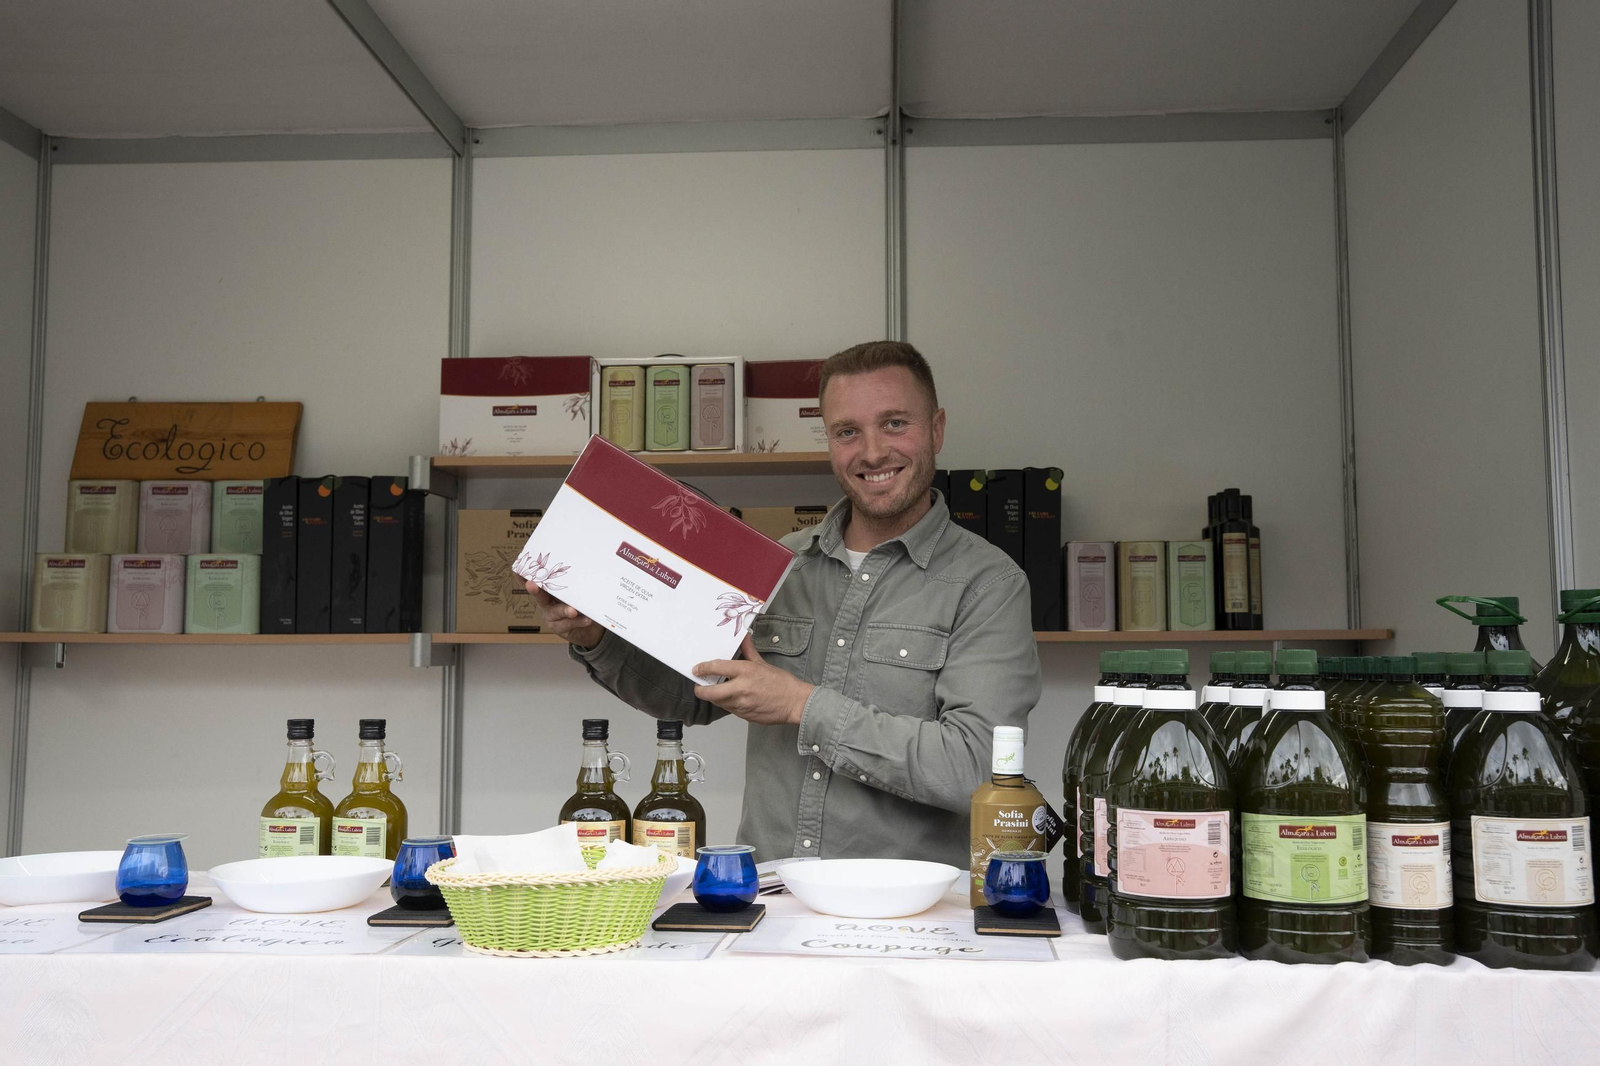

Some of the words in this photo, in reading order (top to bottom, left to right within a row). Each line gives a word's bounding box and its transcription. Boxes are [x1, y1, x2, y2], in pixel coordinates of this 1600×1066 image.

[96, 418, 266, 474] Ecologico
[507, 530, 531, 538] Pras
[620, 576, 635, 588] ACEITE
[641, 588, 653, 598] OLIVA
[620, 582, 635, 594] VIRGEN
[635, 591, 648, 601] EXTRA
[998, 810, 1024, 819] Sofia
[1046, 814, 1057, 828] ofia
[994, 819, 1028, 827] Prasini
[801, 939, 984, 955] Coupage
